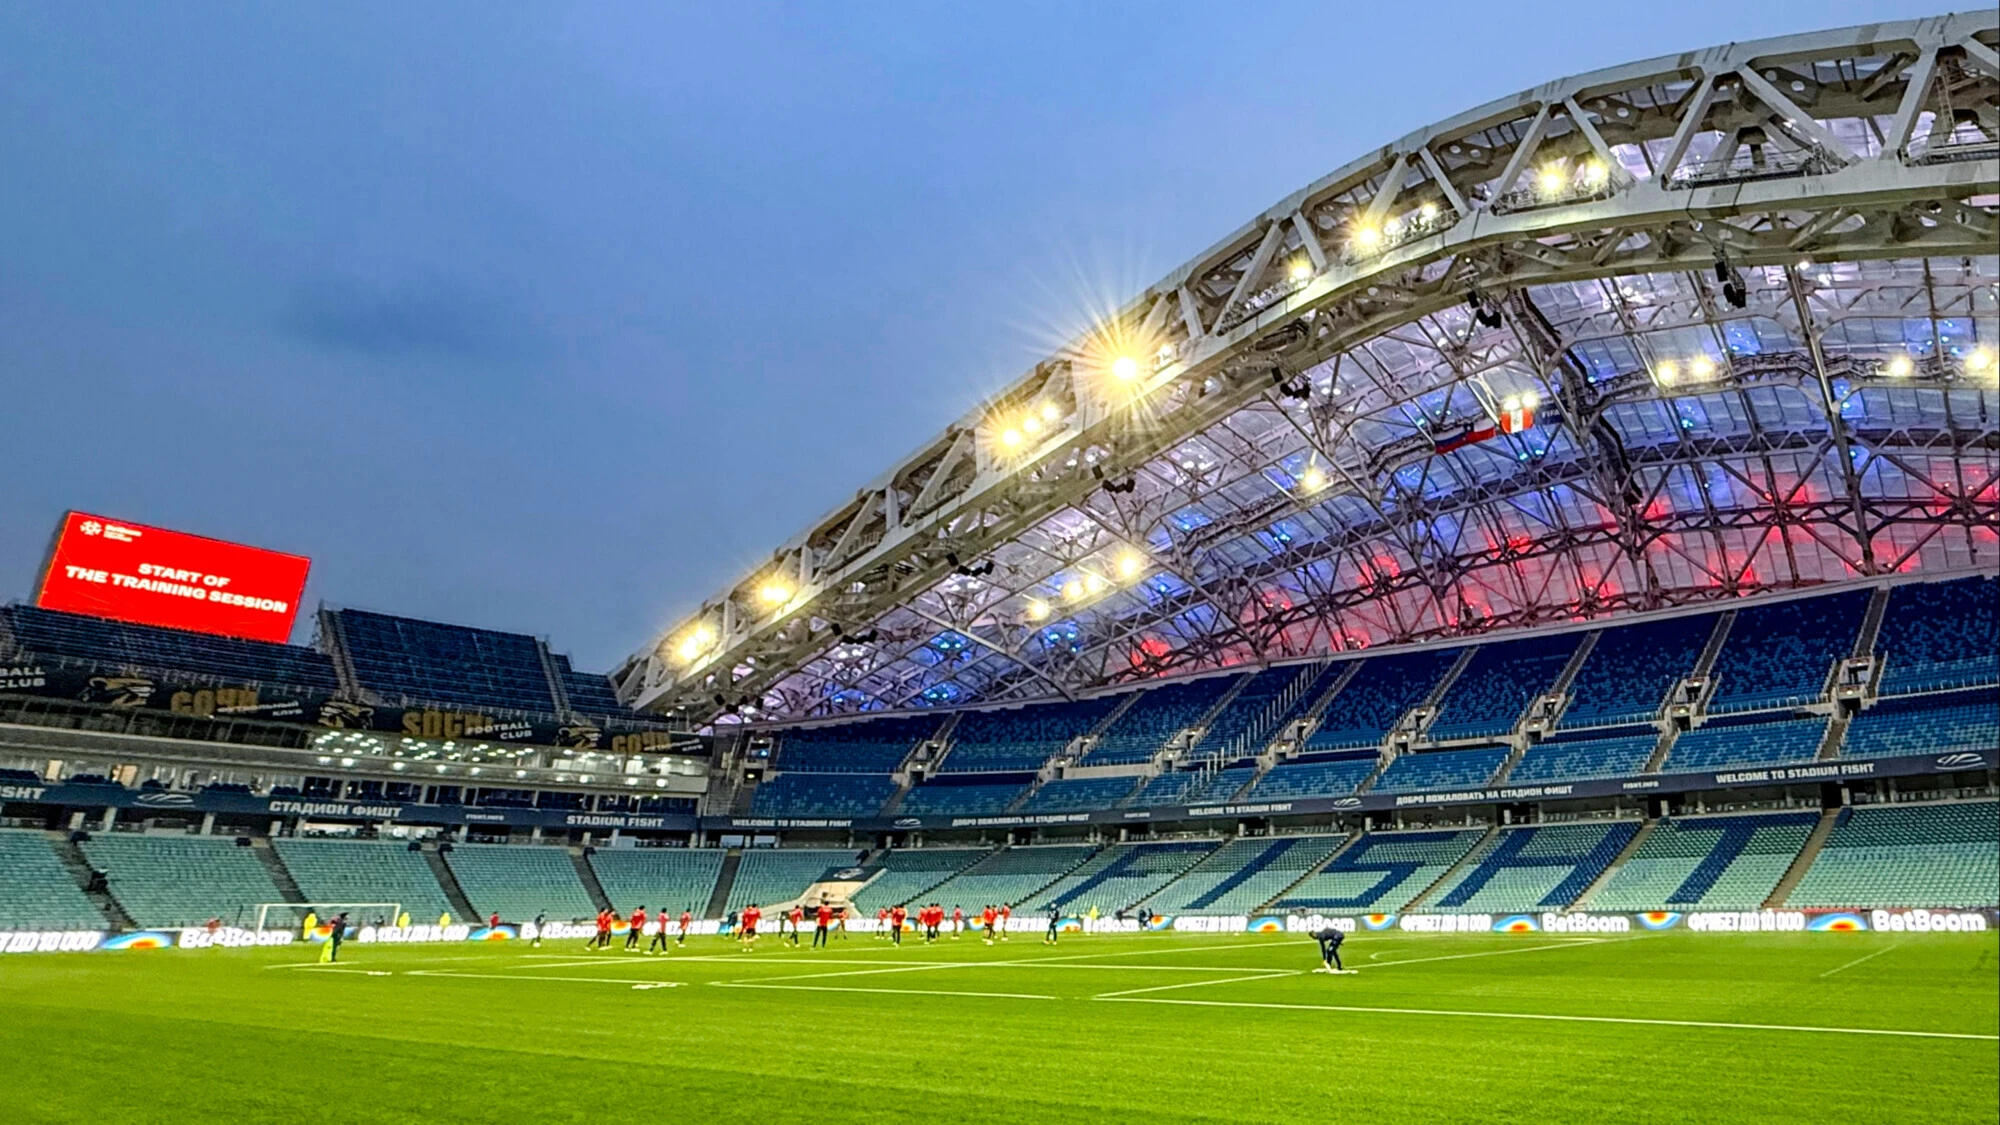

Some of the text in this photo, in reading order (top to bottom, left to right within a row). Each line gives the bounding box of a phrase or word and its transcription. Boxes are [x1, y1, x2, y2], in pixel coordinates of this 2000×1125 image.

[138, 563, 231, 588] START OF
[65, 565, 288, 613] THE TRAINING SESSION
[464, 721, 533, 736] FOOTBALL
[499, 730, 533, 740] CLUB
[1715, 763, 1876, 784] WELCOME TO STADIUM FISHT
[0, 786, 46, 800] SHT
[1396, 785, 1573, 806] ДОБРО ПОЖАЛОВАТЬ НА СТАДИОН ФИШТ
[269, 800, 403, 818] СТАДИОН ФИШТ
[1188, 806, 1225, 816] WELCOME
[1225, 806, 1236, 815] TO
[566, 815, 665, 828] STADIUM FISHT
[732, 818, 853, 828] WELCOME TO STADIUM FISHT
[1542, 913, 1630, 932] BetBoom
[1871, 909, 1987, 932] BetBoom
